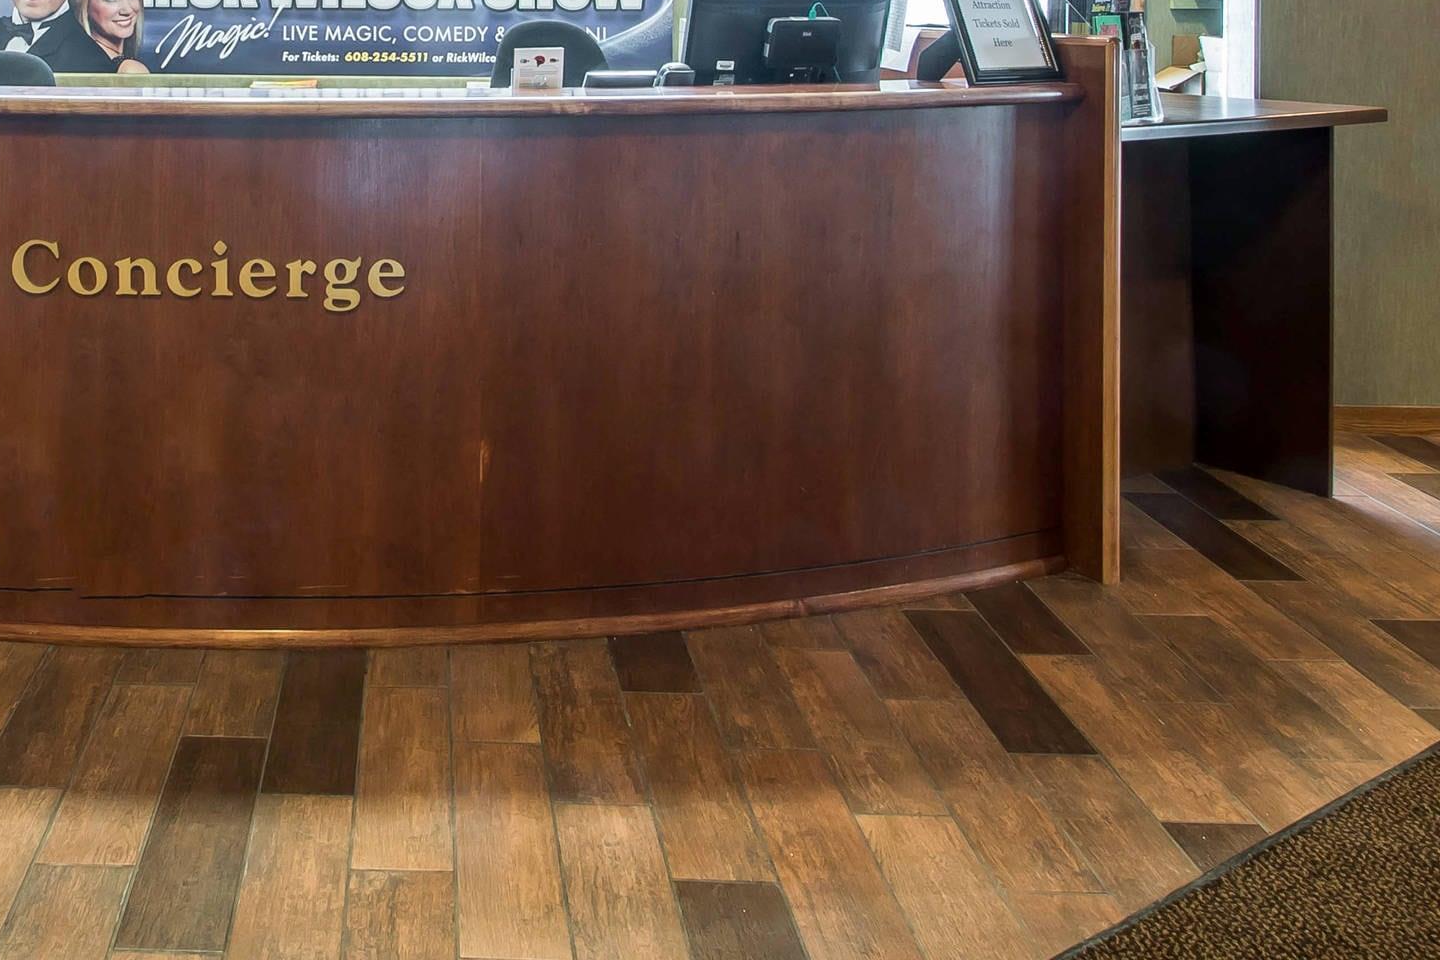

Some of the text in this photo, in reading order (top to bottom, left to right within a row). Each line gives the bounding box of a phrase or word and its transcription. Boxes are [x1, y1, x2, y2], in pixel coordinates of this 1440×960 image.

[972, 0, 1012, 10] Attraction
[972, 18, 1020, 29] Tickets Sold
[155, 5, 284, 69] Magic!
[282, 25, 505, 44] LIVE MAGIC, COMEDY &
[993, 37, 1014, 47] Here
[282, 51, 497, 64] For Tickets: 608-254-5511 or RickWilco
[10, 239, 406, 312] Concierge
